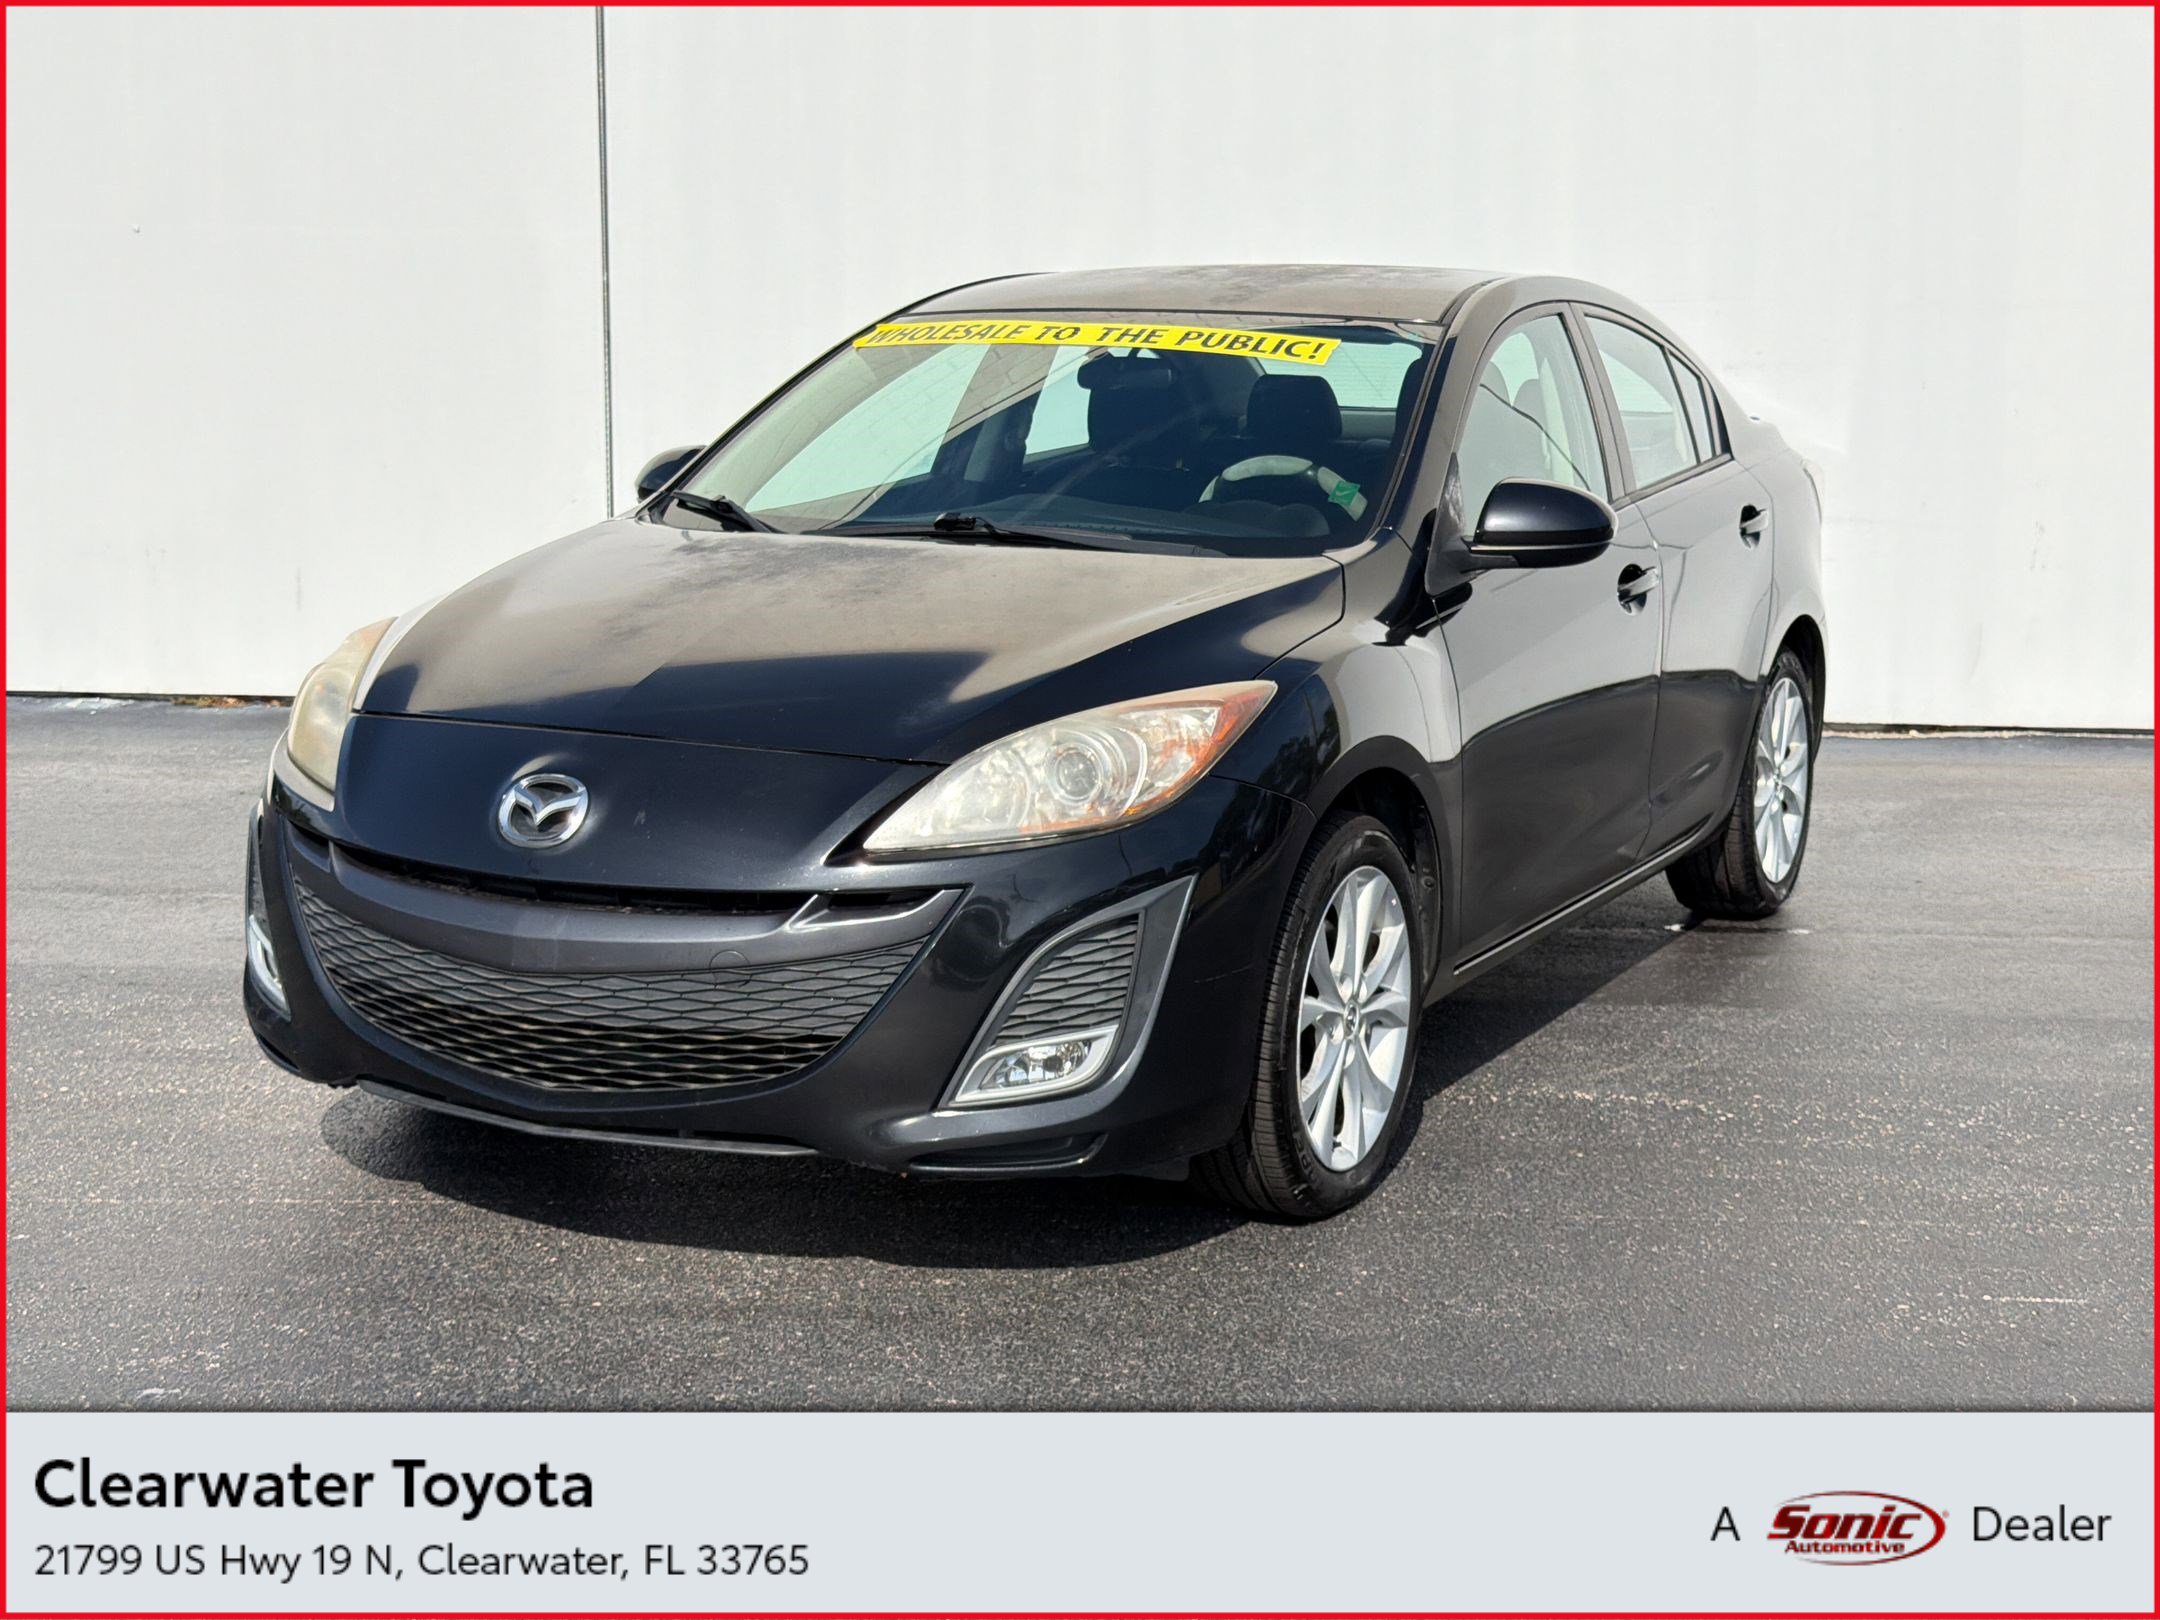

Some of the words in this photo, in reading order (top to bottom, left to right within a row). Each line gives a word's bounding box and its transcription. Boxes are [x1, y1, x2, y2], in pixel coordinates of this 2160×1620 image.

[867, 324, 1032, 344] WHOLESALE
[1035, 325, 1081, 341] TO
[1096, 327, 1172, 345] THE
[1174, 330, 1326, 360] PUBLIC!
